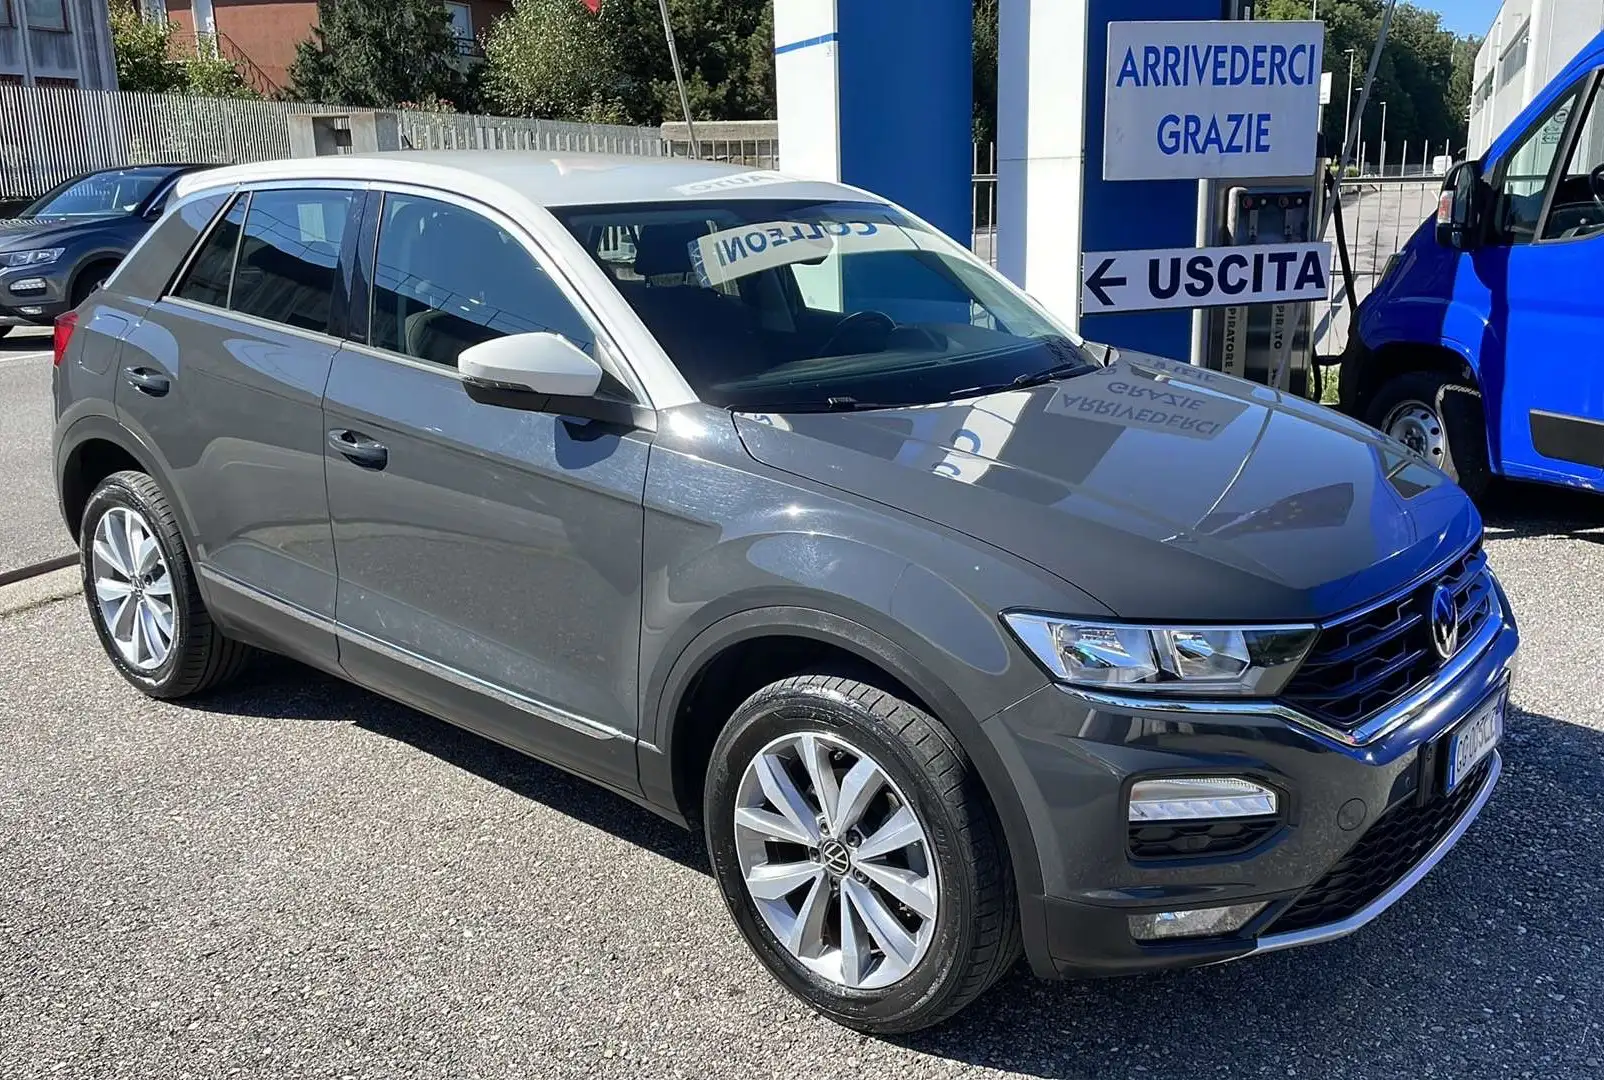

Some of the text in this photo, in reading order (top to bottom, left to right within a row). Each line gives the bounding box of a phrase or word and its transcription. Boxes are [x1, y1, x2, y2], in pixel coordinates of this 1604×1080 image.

[1116, 43, 1316, 87] ARRIVEDERCI
[1156, 112, 1272, 156] GRAZIE
[1148, 250, 1327, 300] USCITA
